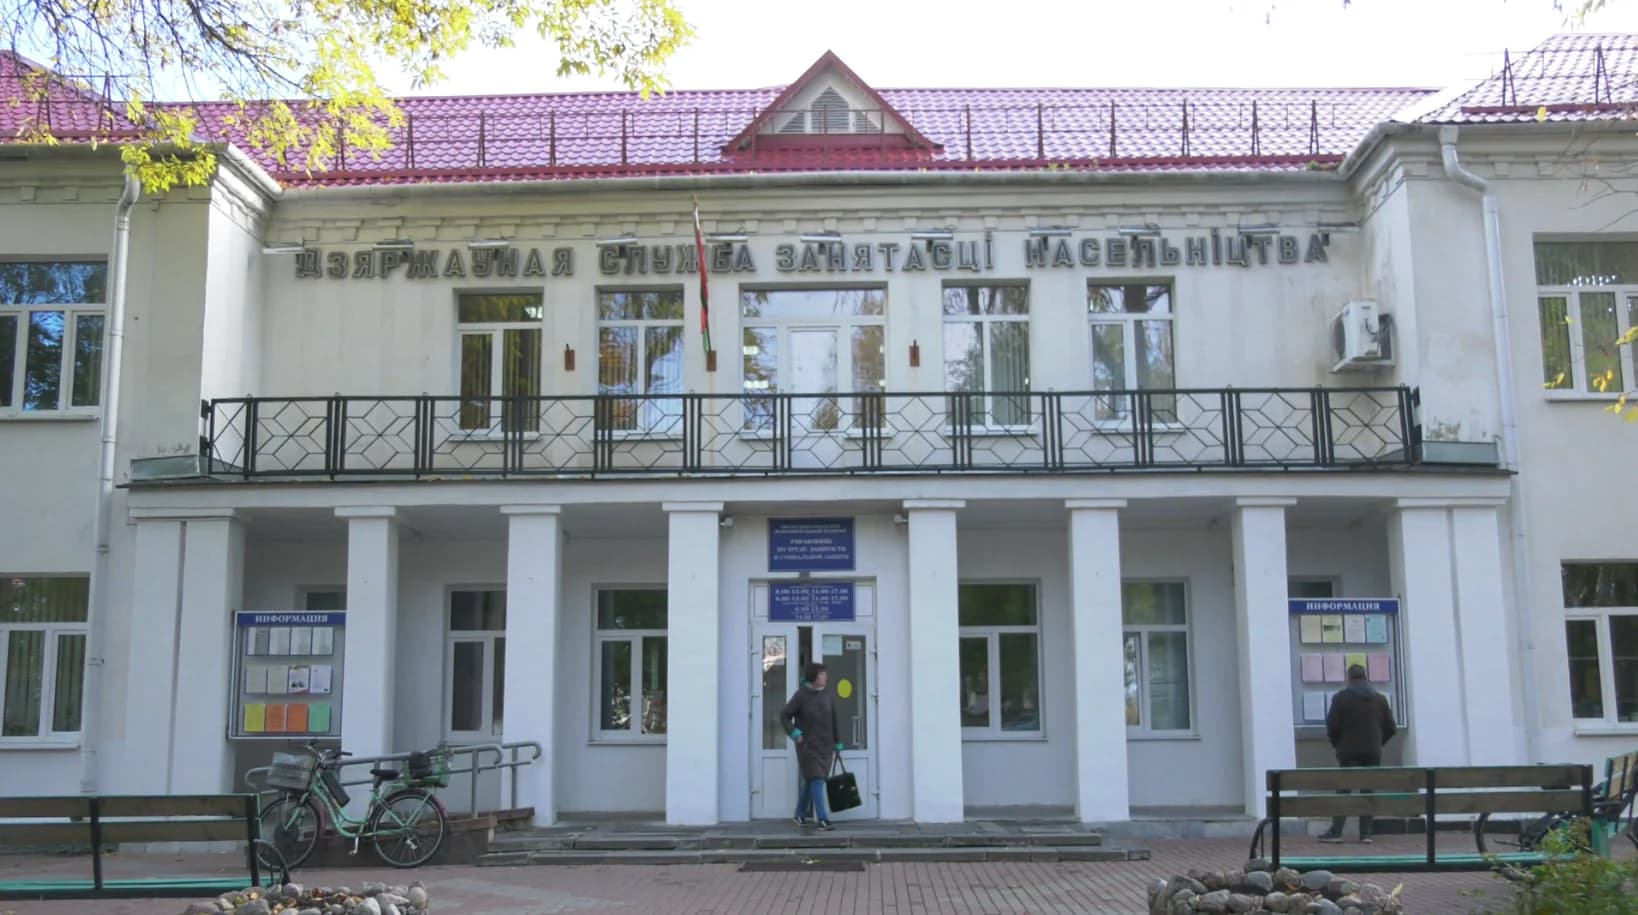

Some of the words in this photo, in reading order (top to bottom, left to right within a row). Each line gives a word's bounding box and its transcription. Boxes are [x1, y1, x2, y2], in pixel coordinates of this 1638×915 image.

[599, 243, 756, 275] СЛУЖБА
[775, 234, 994, 272] ЗАНЯТАСЦІ
[1024, 228, 1330, 269] НАСЕЛЬНІЦТВА
[1306, 602, 1380, 610] ИНФОРМАЦИЯ
[255, 615, 328, 623] ИНФОРМАЦИЯ
